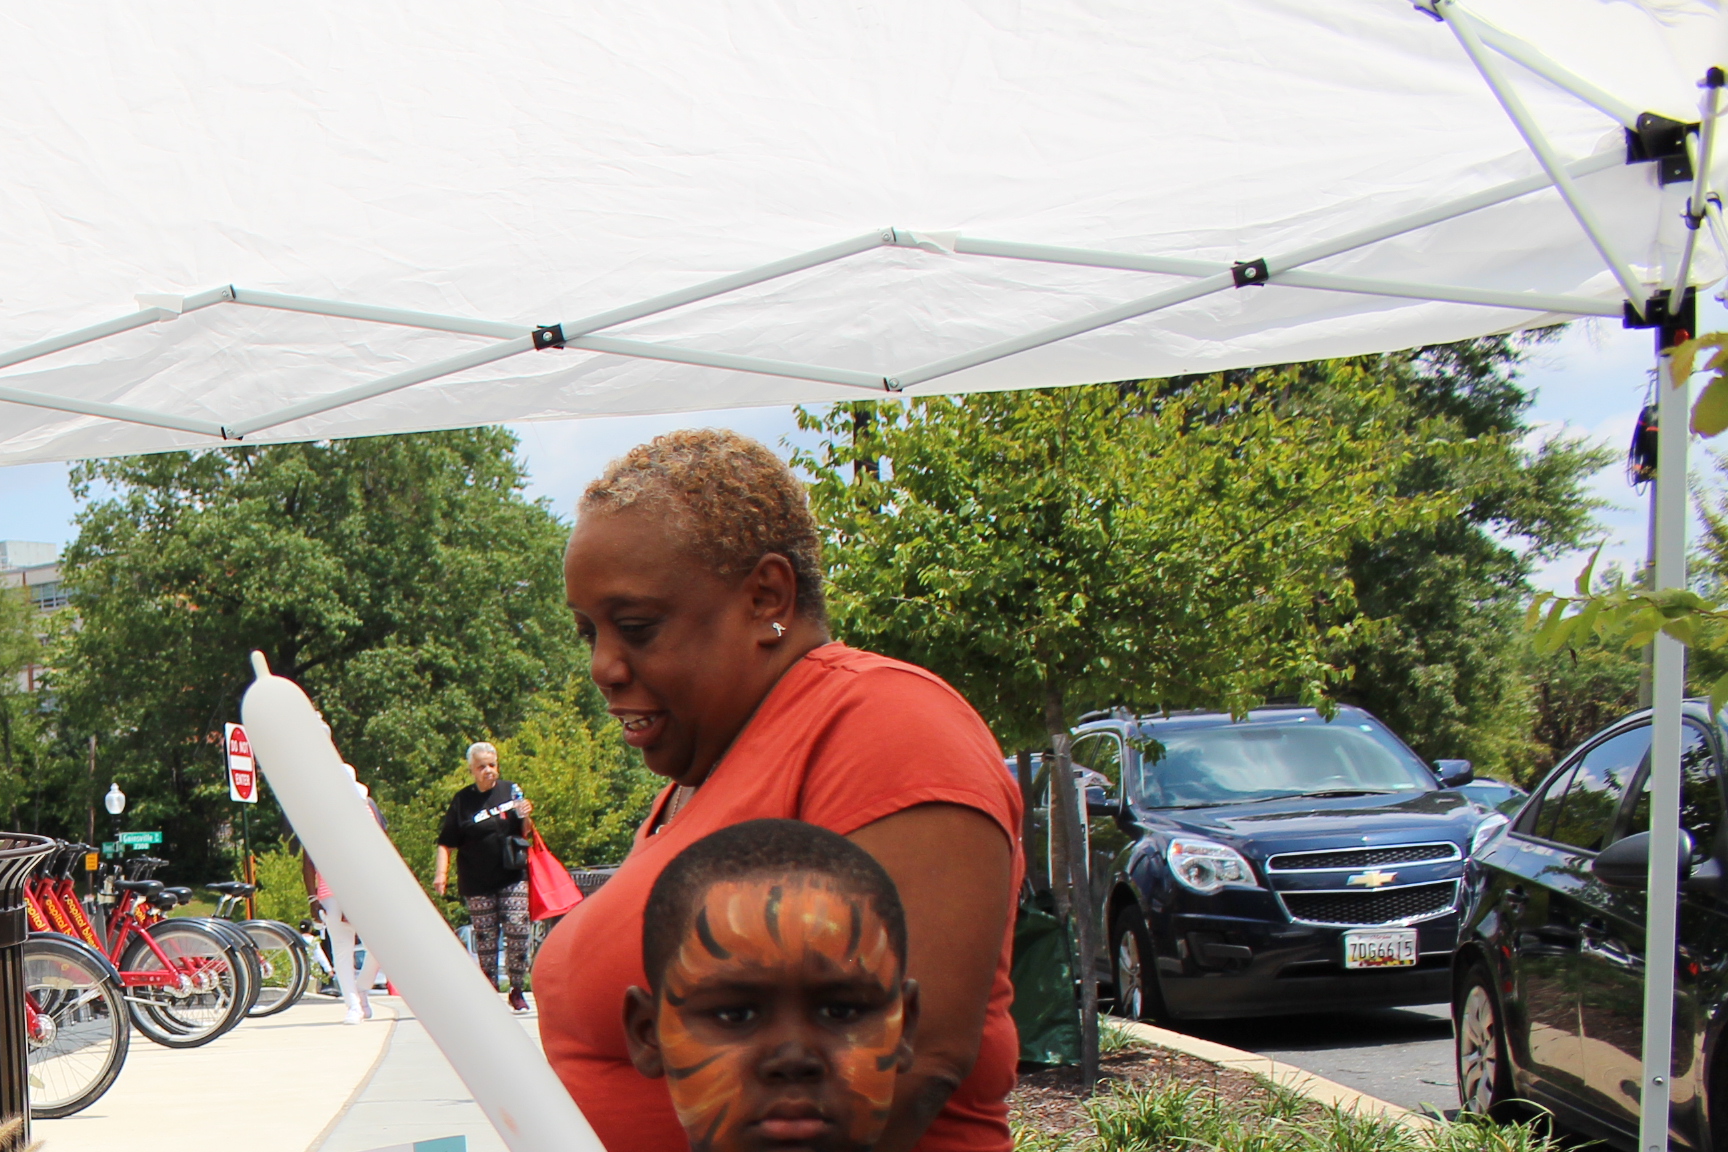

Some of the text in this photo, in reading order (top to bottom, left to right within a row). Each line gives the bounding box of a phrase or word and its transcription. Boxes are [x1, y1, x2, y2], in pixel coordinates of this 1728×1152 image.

[231, 739, 250, 754] DO NOT
[235, 773, 250, 787] ENTER
[66, 898, 87, 928] capital
